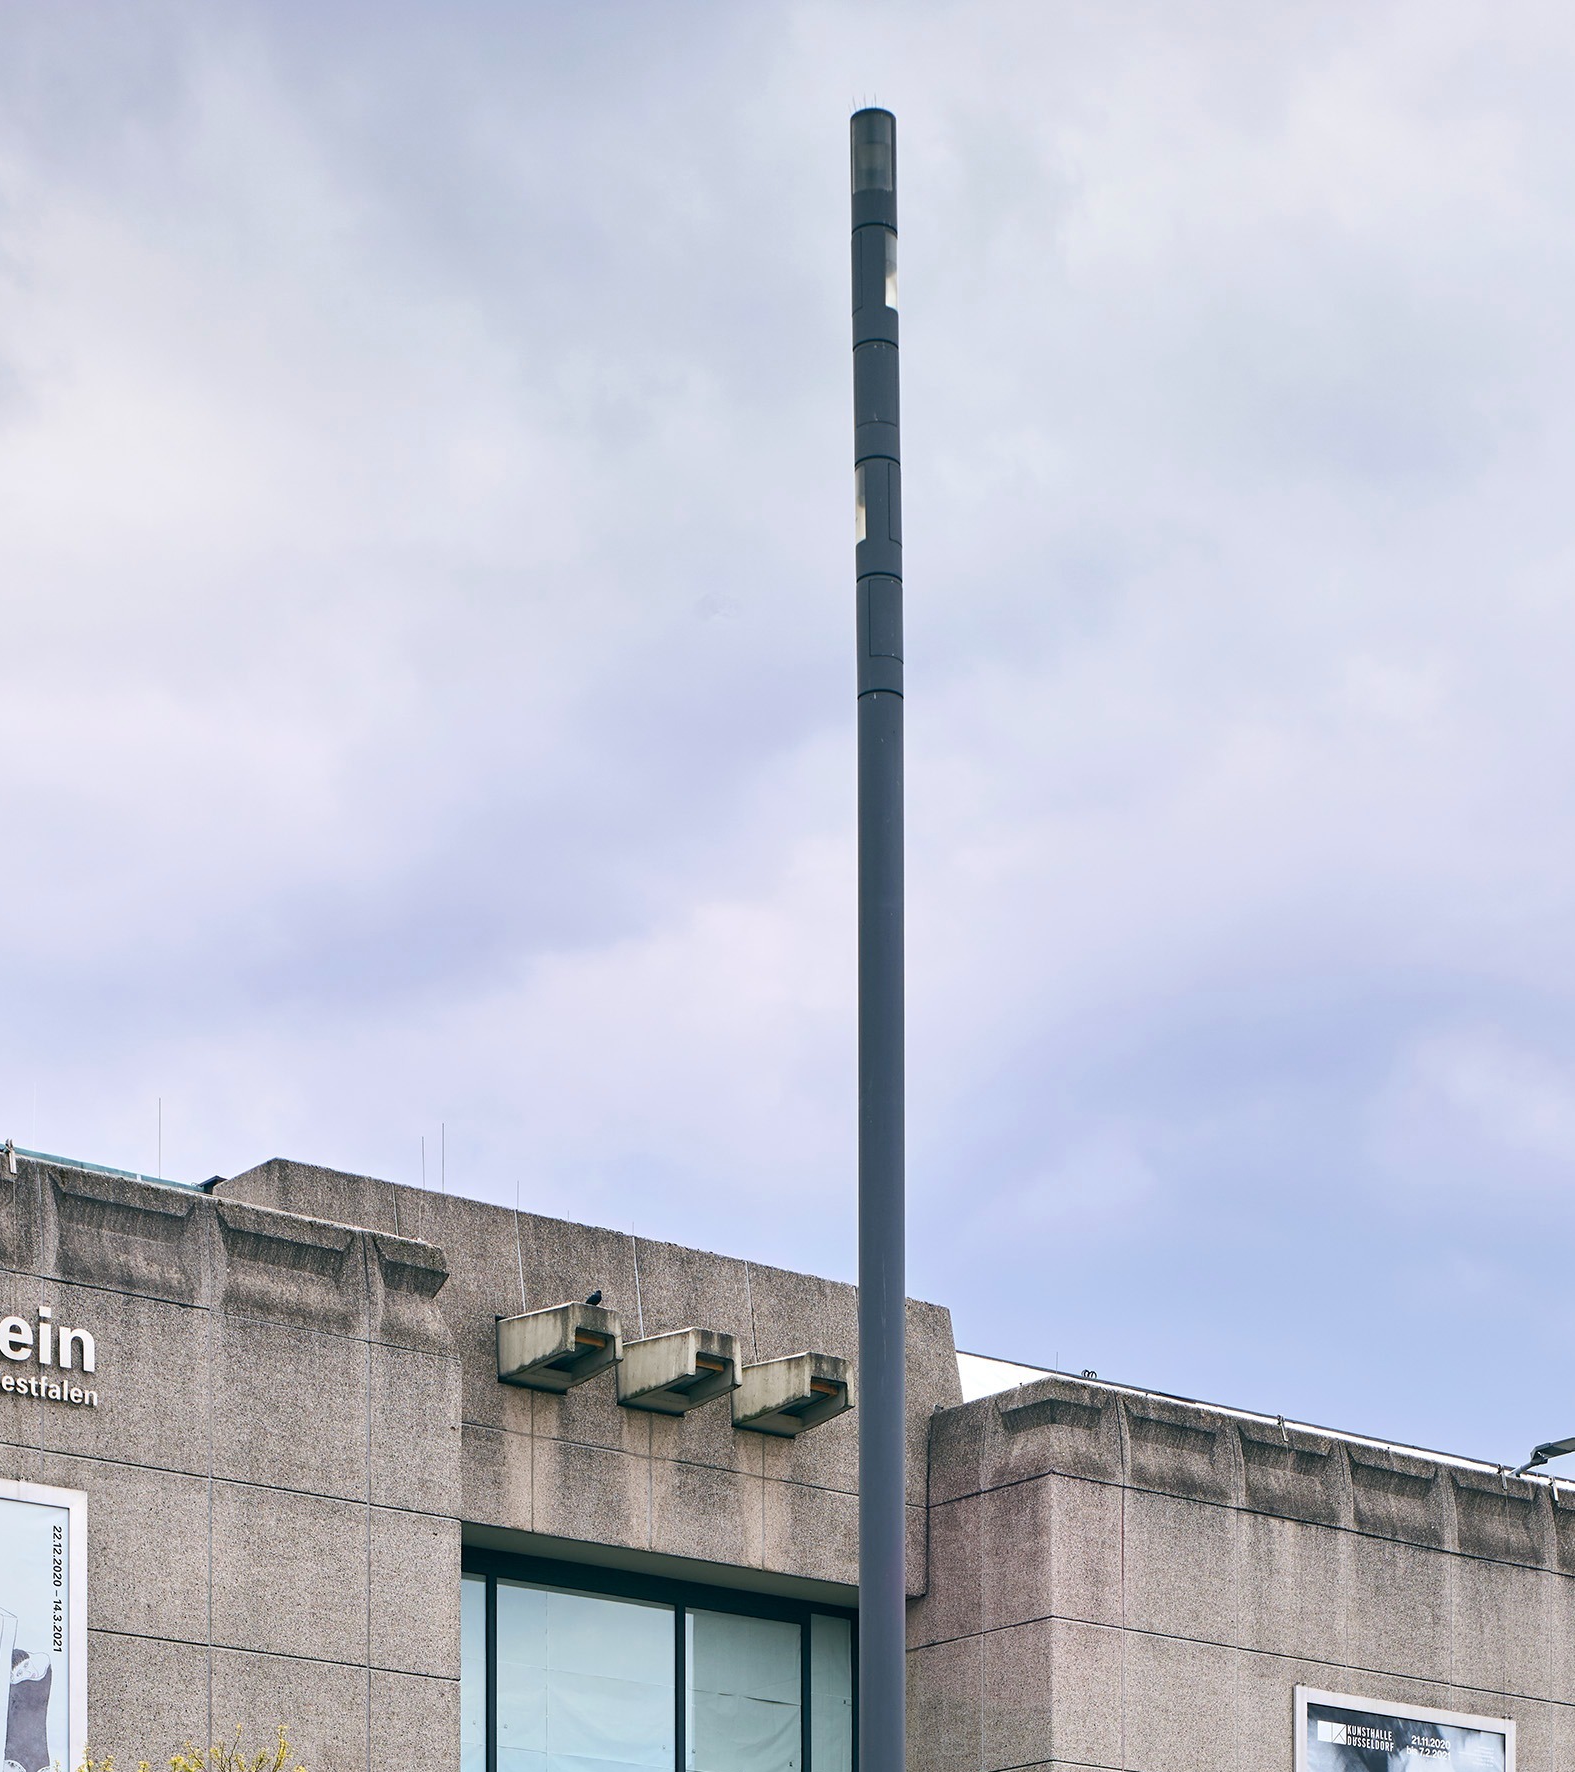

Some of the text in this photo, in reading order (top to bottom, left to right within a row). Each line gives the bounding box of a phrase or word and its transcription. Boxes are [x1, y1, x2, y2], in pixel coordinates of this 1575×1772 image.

[53, 1525, 62, 1587] 22.12.2020
[53, 1599, 62, 1653] 14.3.2021
[1347, 1724, 1451, 1750] KUNSTHALLE 21.11.2020
[1406, 1745, 1419, 1755] bis
[1419, 1748, 1452, 1761] 7.2.2021
